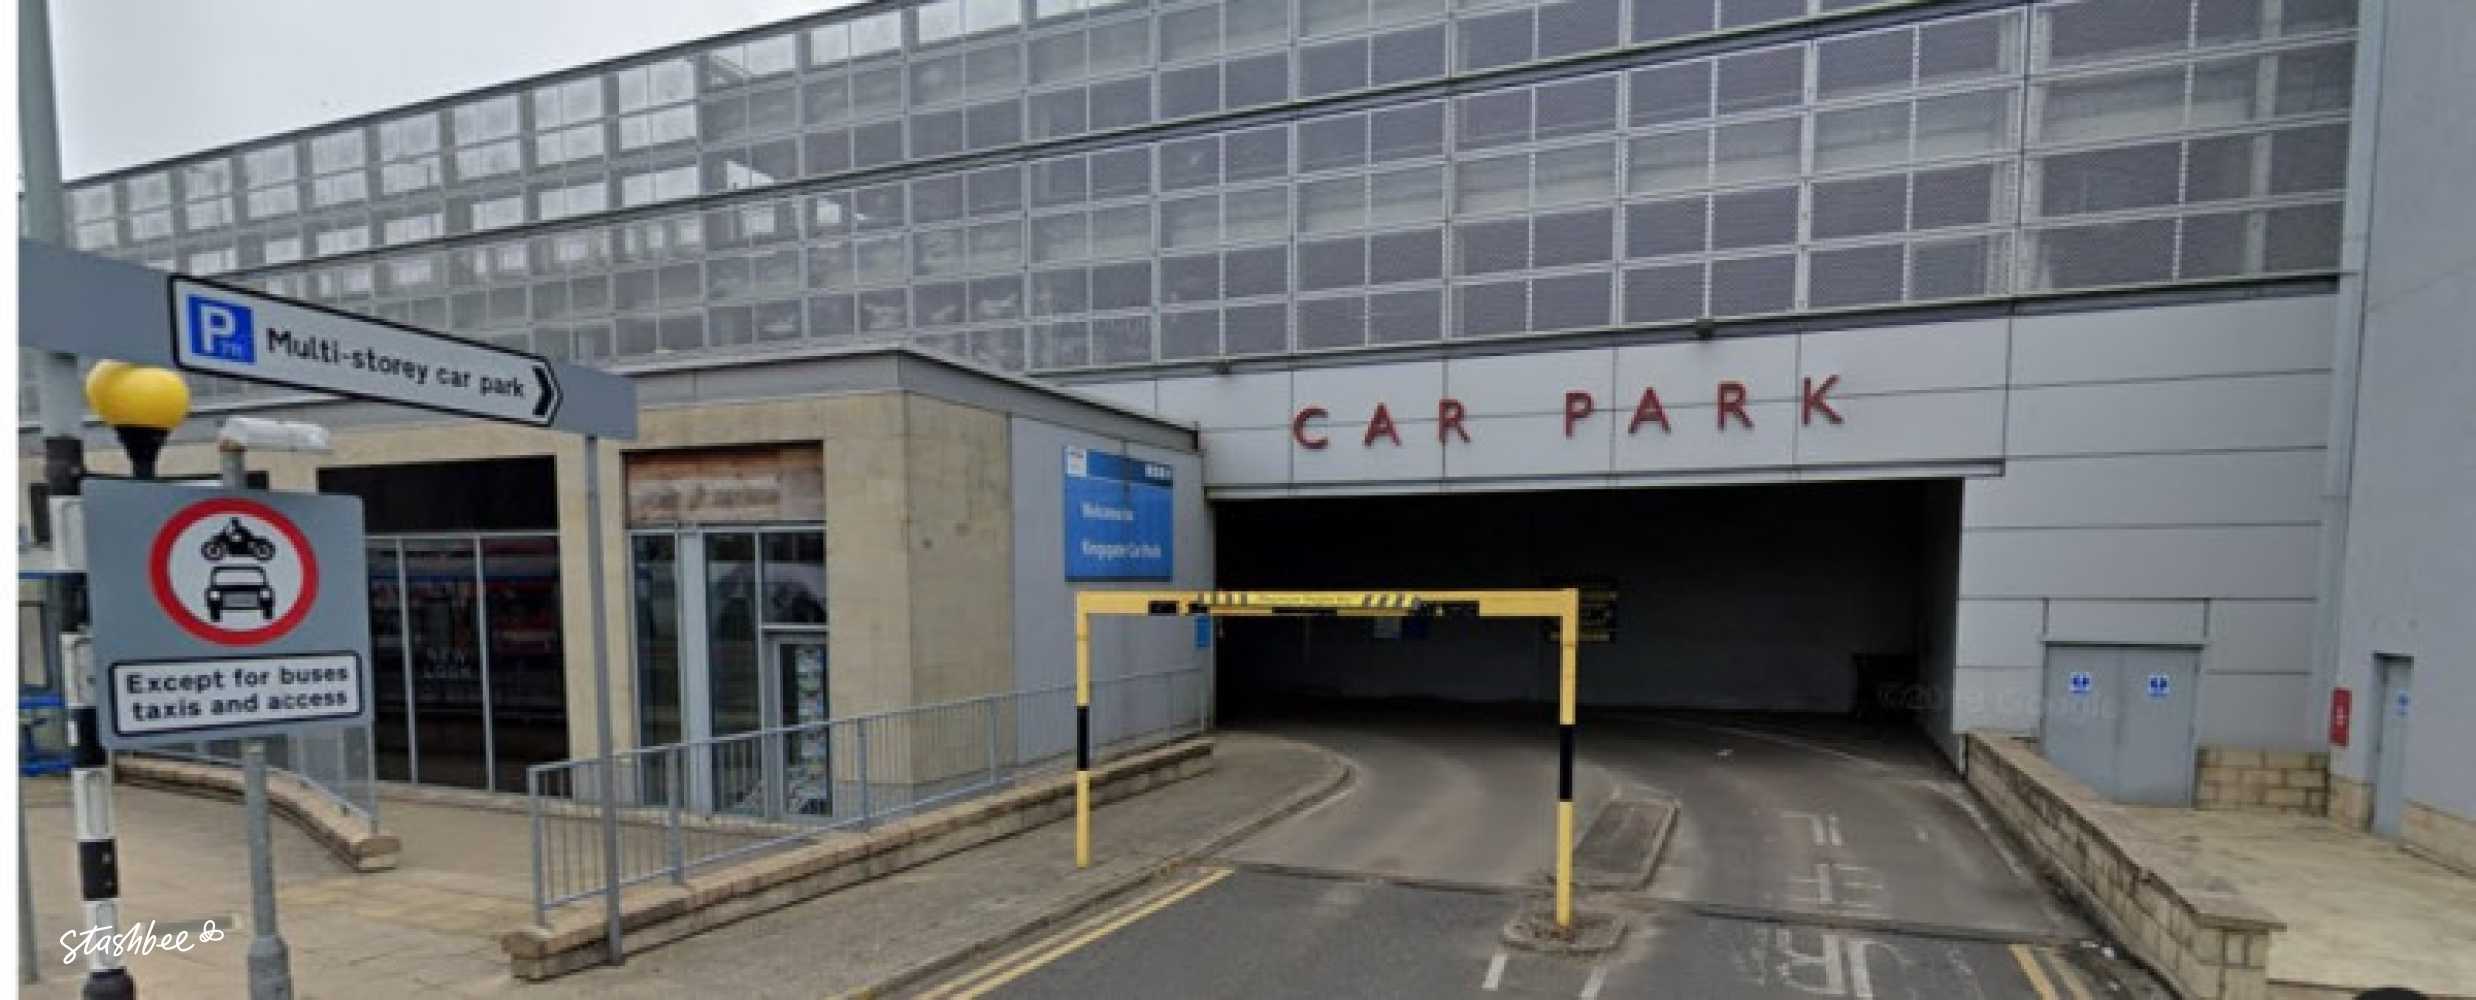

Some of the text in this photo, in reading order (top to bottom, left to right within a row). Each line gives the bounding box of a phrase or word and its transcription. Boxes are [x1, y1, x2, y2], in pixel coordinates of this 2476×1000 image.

[198, 302, 237, 353] P
[265, 327, 429, 386] Multi-storey
[436, 365, 472, 388] car
[480, 375, 526, 400] park
[1292, 374, 1844, 451] CAR PARK
[126, 665, 348, 695] Except for buses
[132, 690, 348, 722] taxis and access
